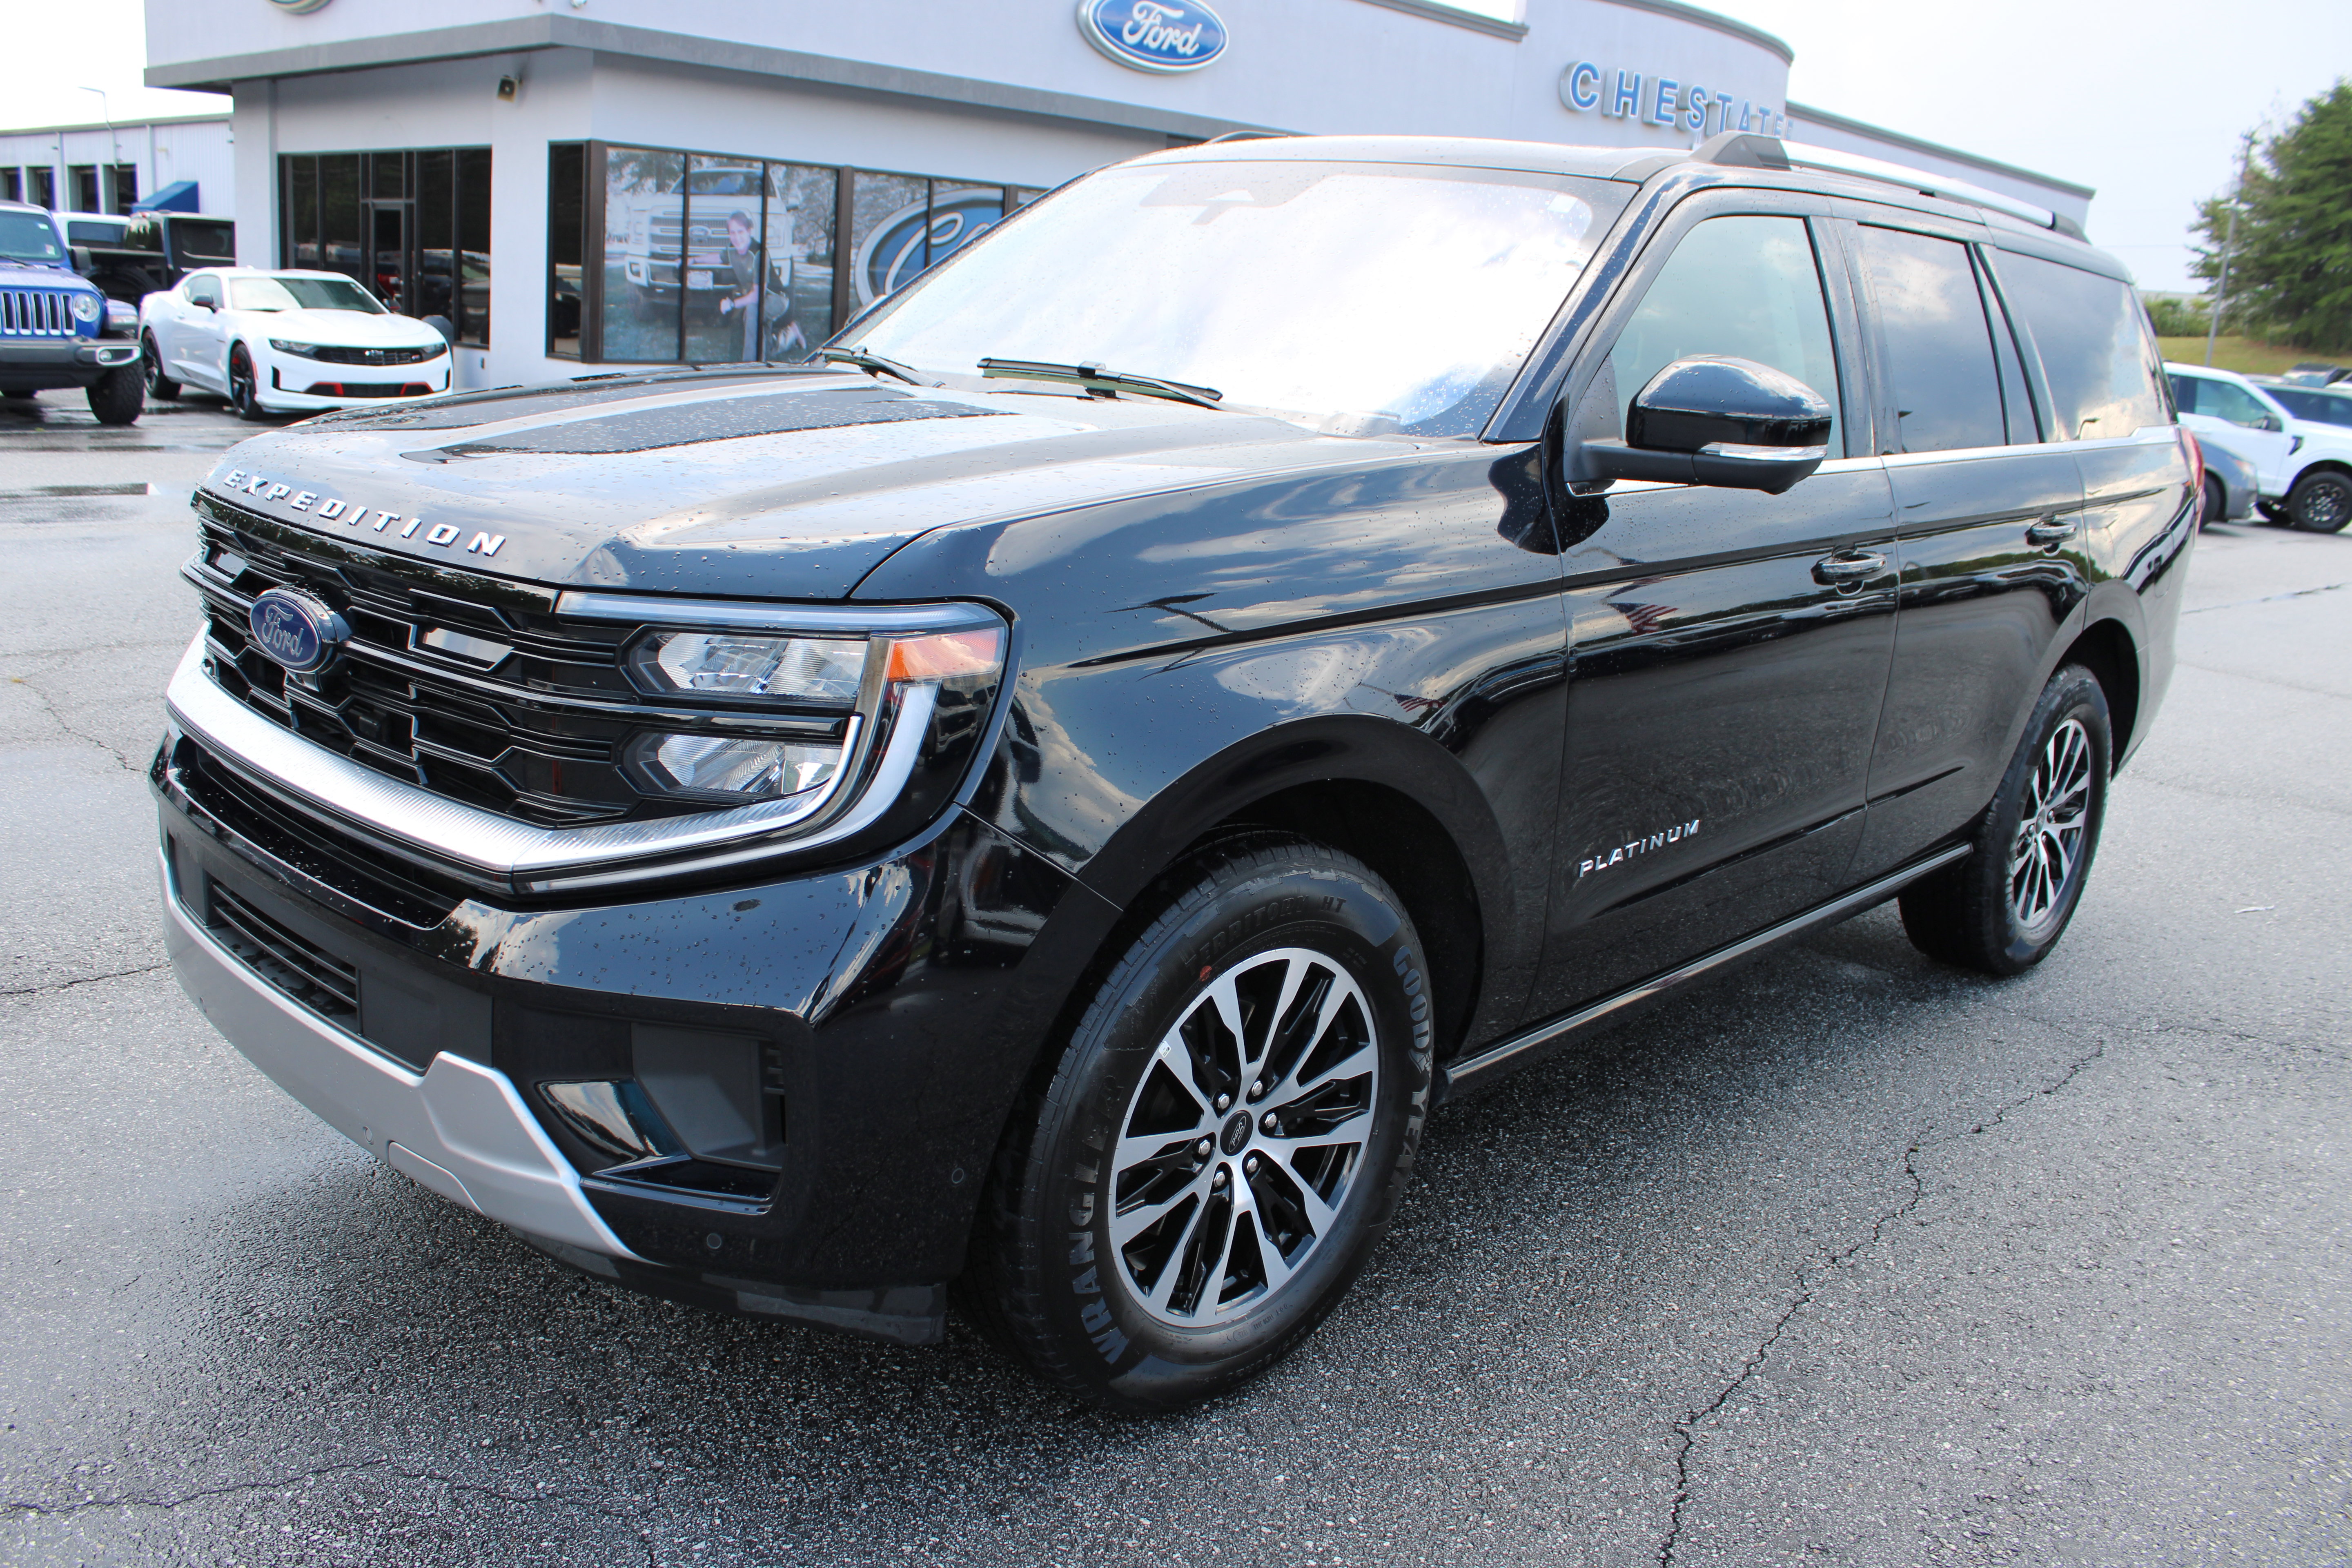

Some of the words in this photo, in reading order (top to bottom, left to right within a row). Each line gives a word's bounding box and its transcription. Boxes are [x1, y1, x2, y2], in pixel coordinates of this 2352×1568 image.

[1123, 0, 1202, 56] Ford
[223, 469, 507, 557] EXPEDITION
[262, 604, 304, 658] Ford
[1579, 820, 1700, 878] PLATINUM
[1183, 896, 1309, 976] TERRITORY
[1321, 895, 1347, 913] HT
[1385, 945, 1432, 1204] GOODYEAR
[1069, 1076, 1129, 1365] WRANGLER
